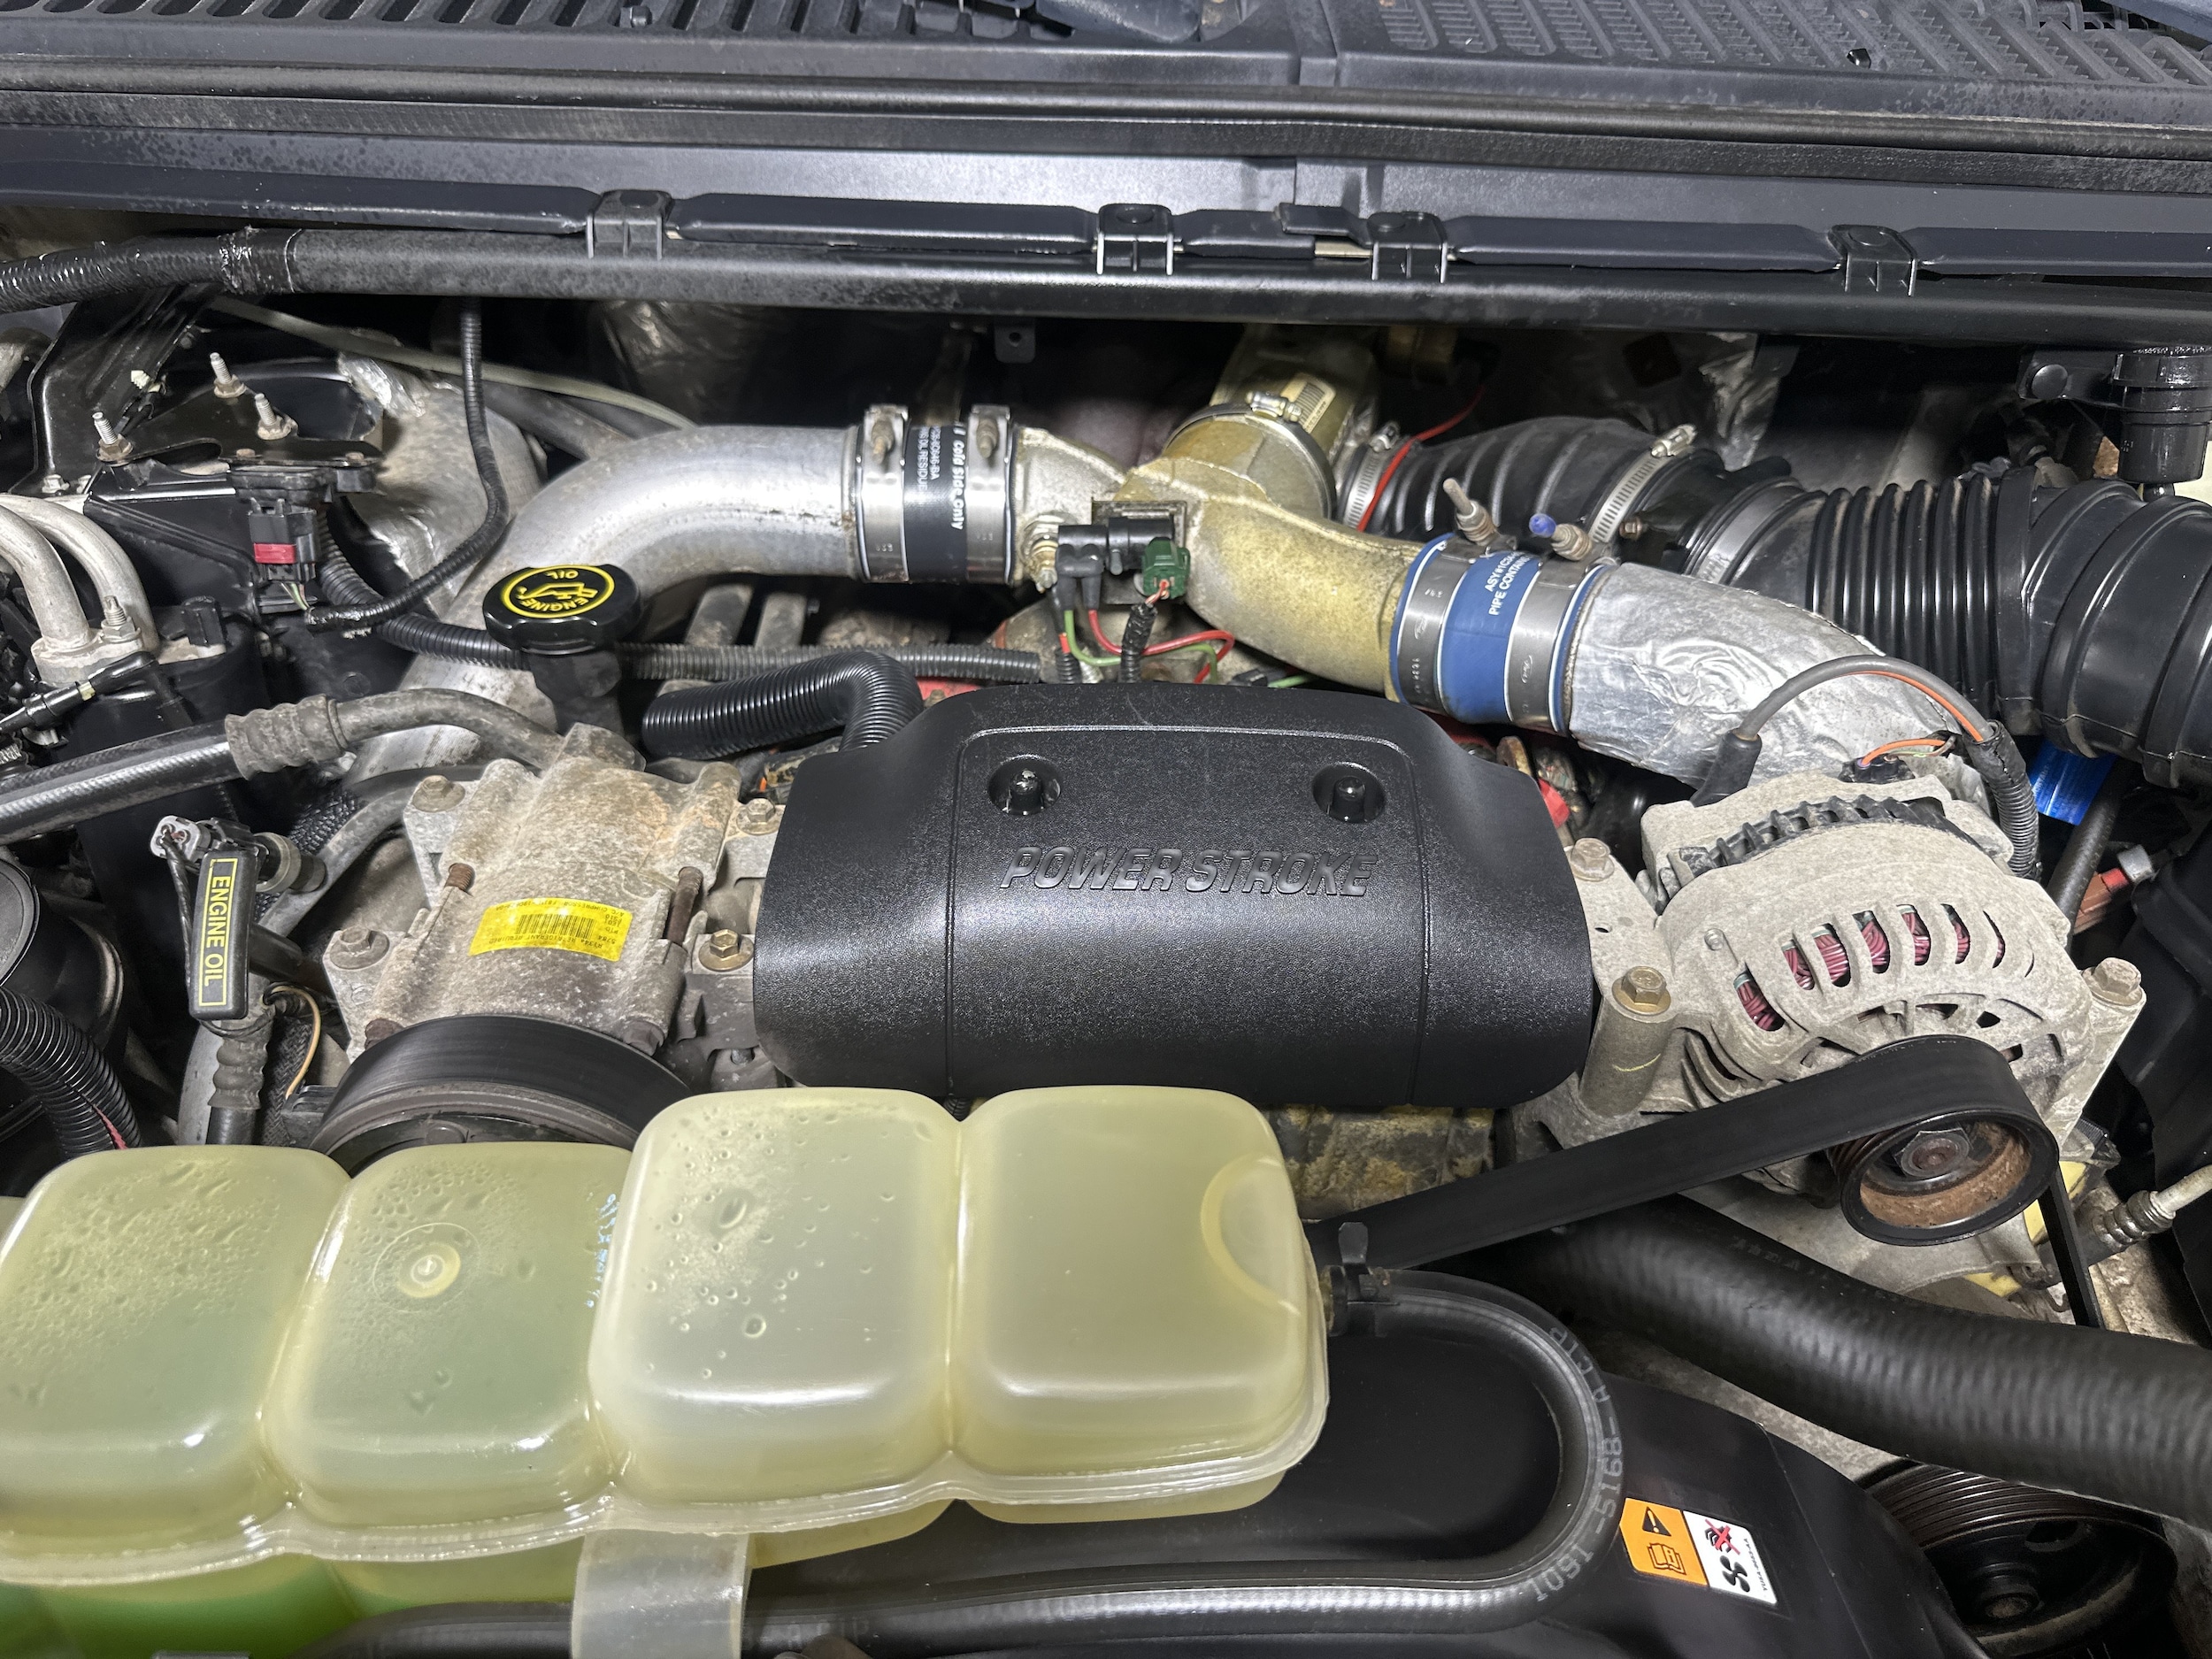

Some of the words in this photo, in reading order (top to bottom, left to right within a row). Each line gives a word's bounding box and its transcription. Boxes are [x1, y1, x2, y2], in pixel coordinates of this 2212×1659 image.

[917, 449, 928, 491] RESIDUE
[546, 570, 579, 580] OIL
[520, 597, 589, 611] ENGINE
[1488, 590, 1507, 615] PIPE
[999, 846, 1184, 891] POWER
[1185, 849, 1379, 896] STROKE
[206, 875, 232, 949] ENGINE
[204, 953, 224, 987] OIL
